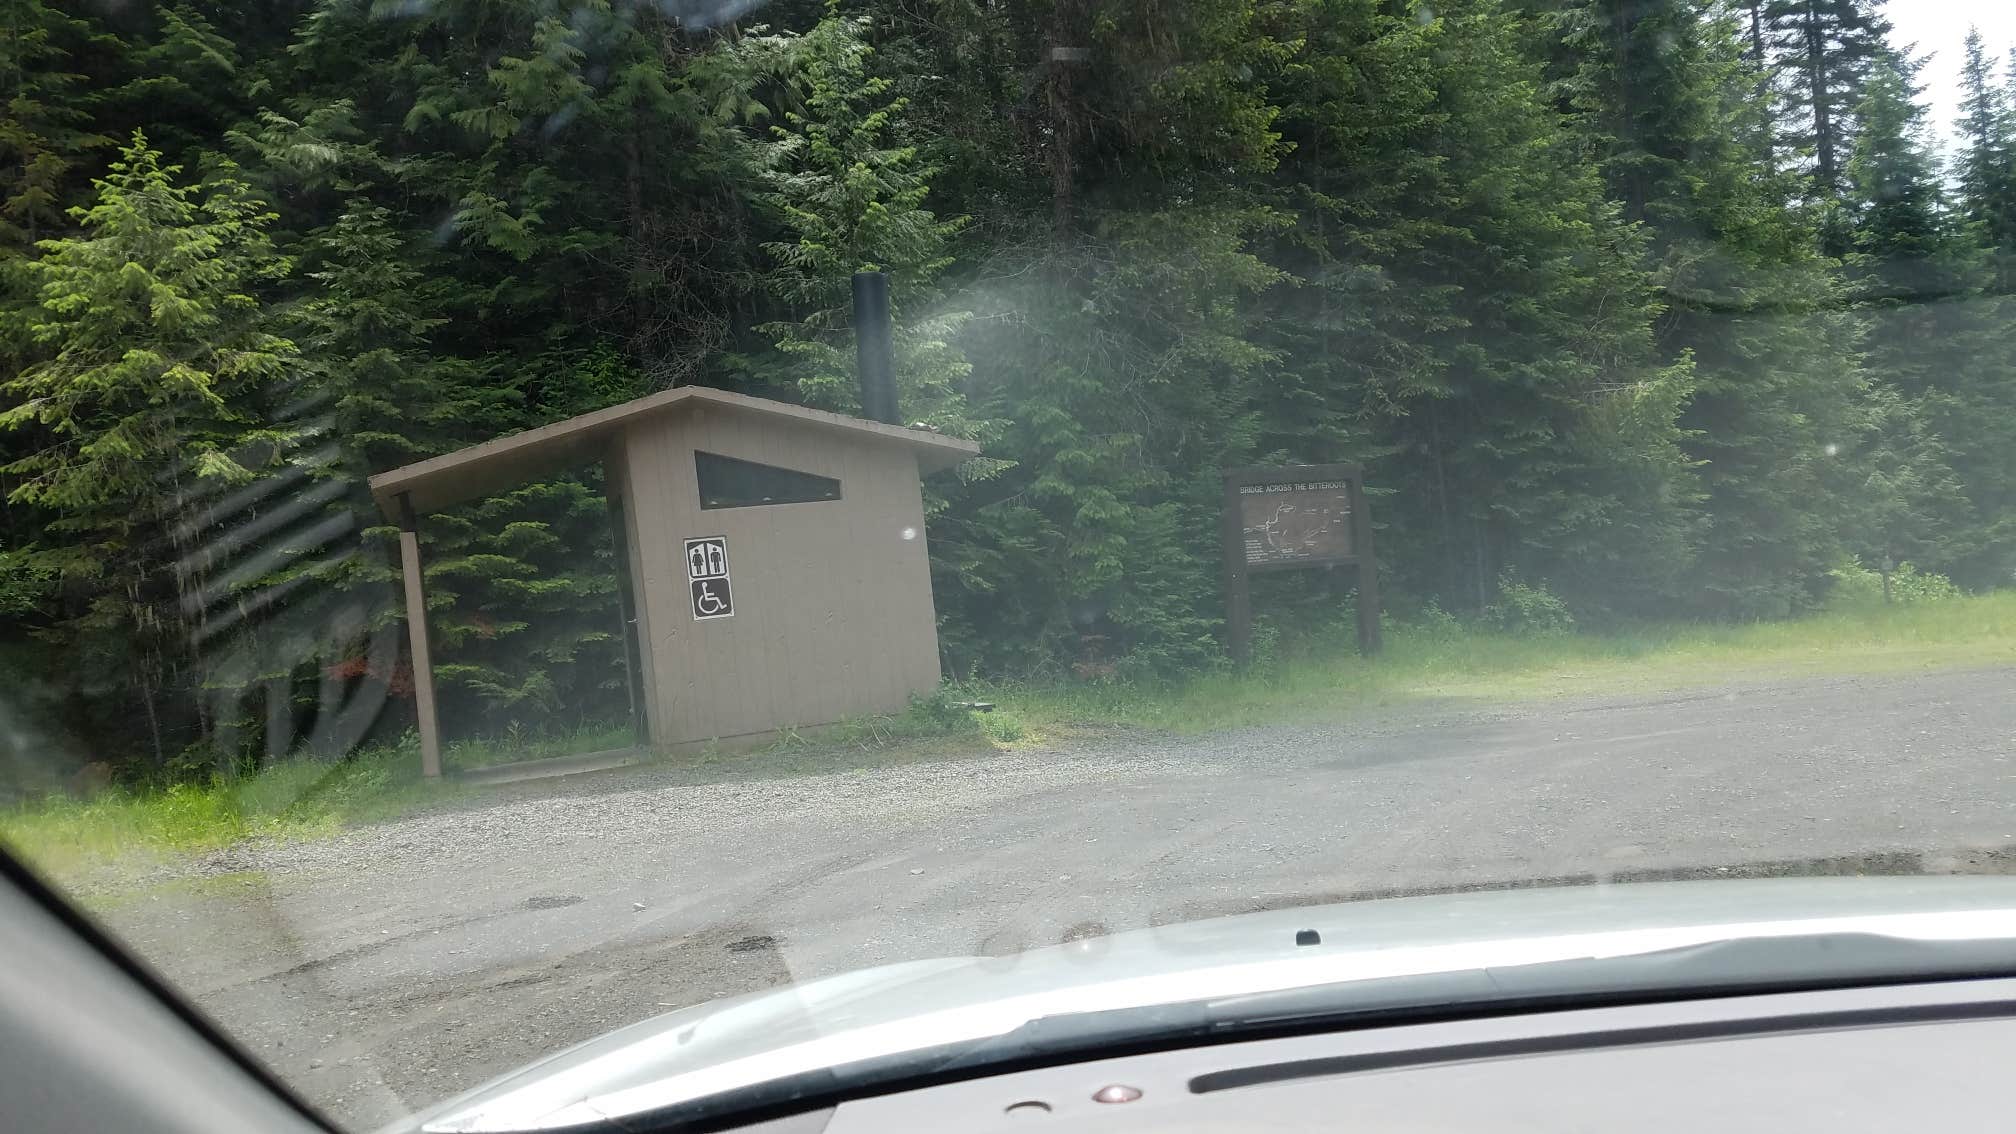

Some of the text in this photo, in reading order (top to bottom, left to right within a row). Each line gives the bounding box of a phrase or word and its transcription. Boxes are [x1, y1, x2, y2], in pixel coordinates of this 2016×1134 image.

[1240, 485, 1264, 494] BRIDGE
[1265, 484, 1293, 493] ACROSS
[1294, 483, 1307, 491] THE
